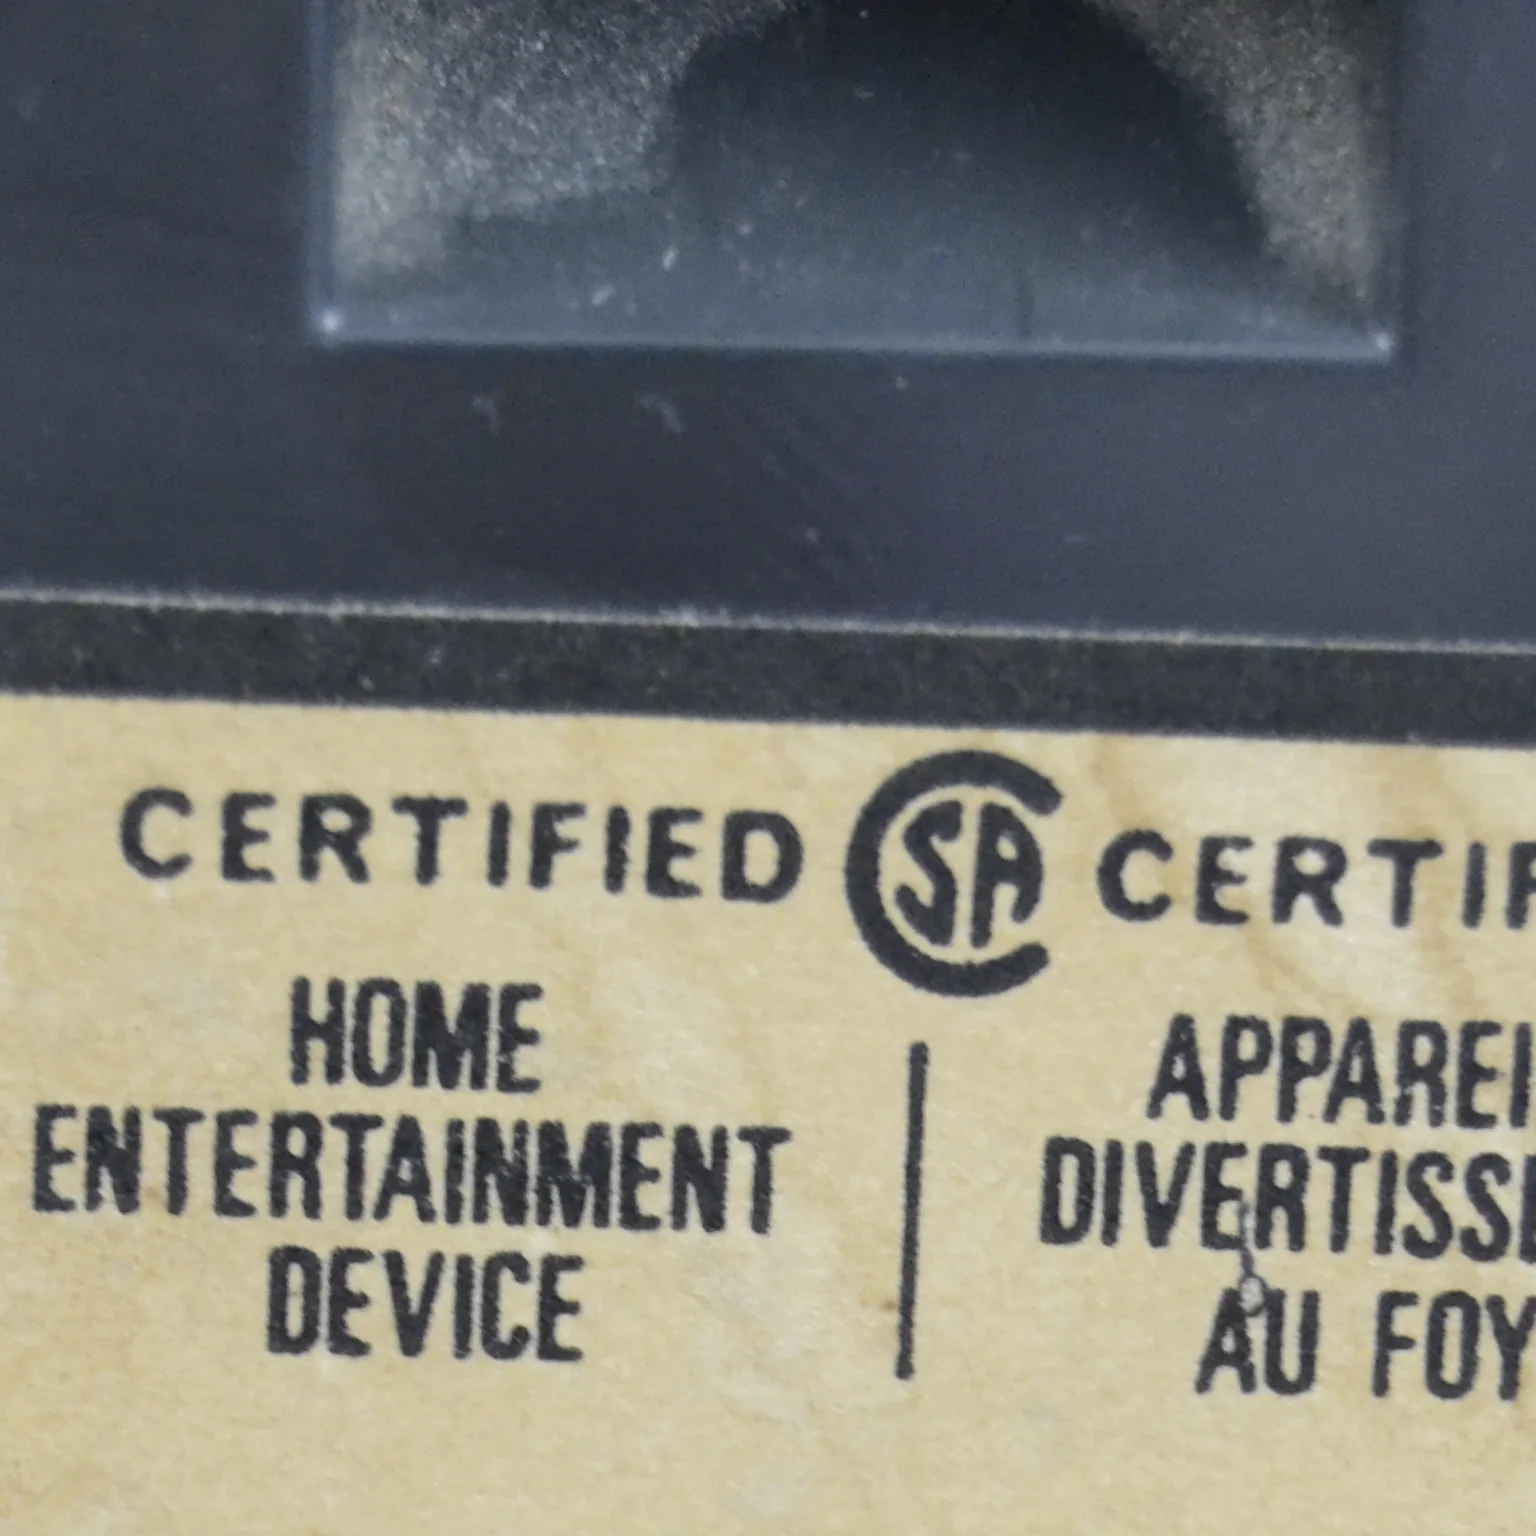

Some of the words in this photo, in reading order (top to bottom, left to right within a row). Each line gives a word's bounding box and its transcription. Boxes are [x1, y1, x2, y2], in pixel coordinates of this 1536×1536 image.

[119, 786, 804, 904] CERTIFIED
[843, 749, 1063, 998] CSA
[289, 976, 544, 1095] HOME
[32, 1103, 792, 1235] ENTERTAINMENT
[266, 1244, 585, 1362] DEVICE
[1194, 1286, 1320, 1397] AU
